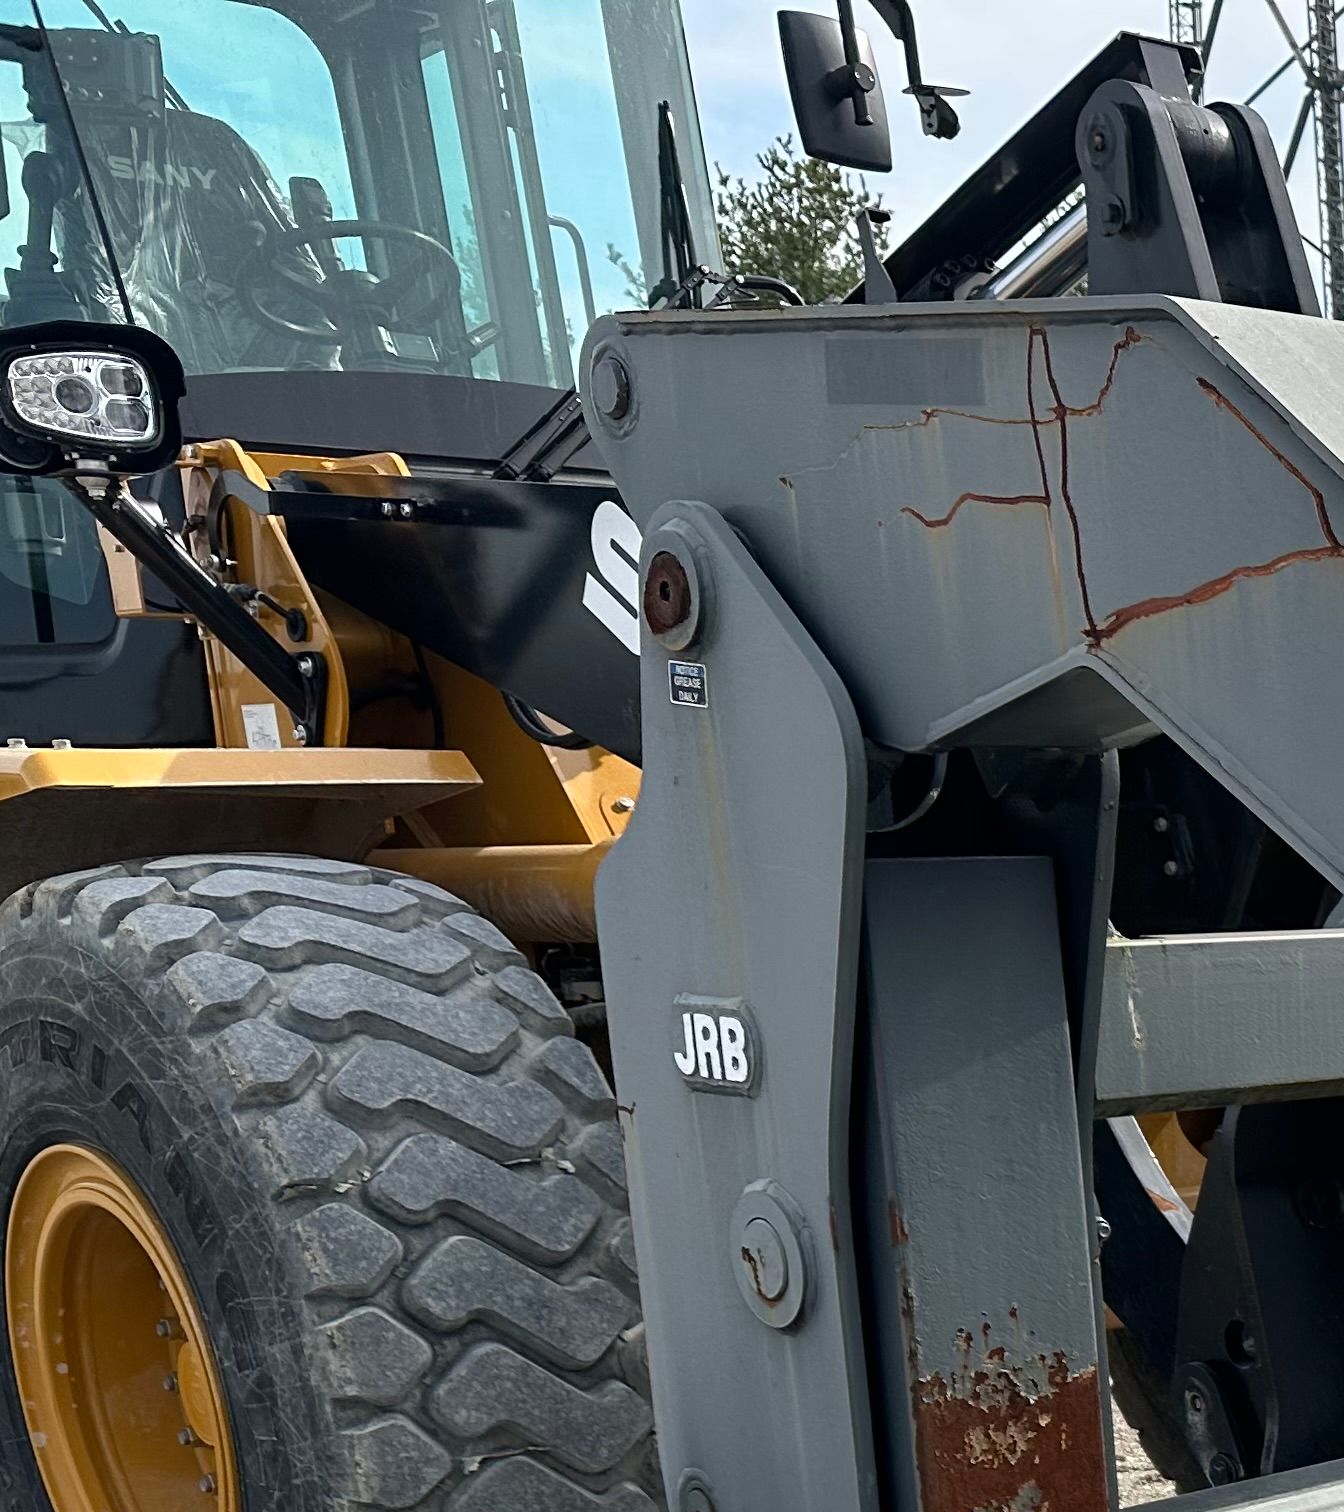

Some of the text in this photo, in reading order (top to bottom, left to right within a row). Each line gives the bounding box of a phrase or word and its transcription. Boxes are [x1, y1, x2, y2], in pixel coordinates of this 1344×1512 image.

[107, 155, 216, 189] SANY
[674, 676, 701, 689] GREASE
[679, 691, 698, 702] DAILY
[674, 1013, 748, 1082] JRB
